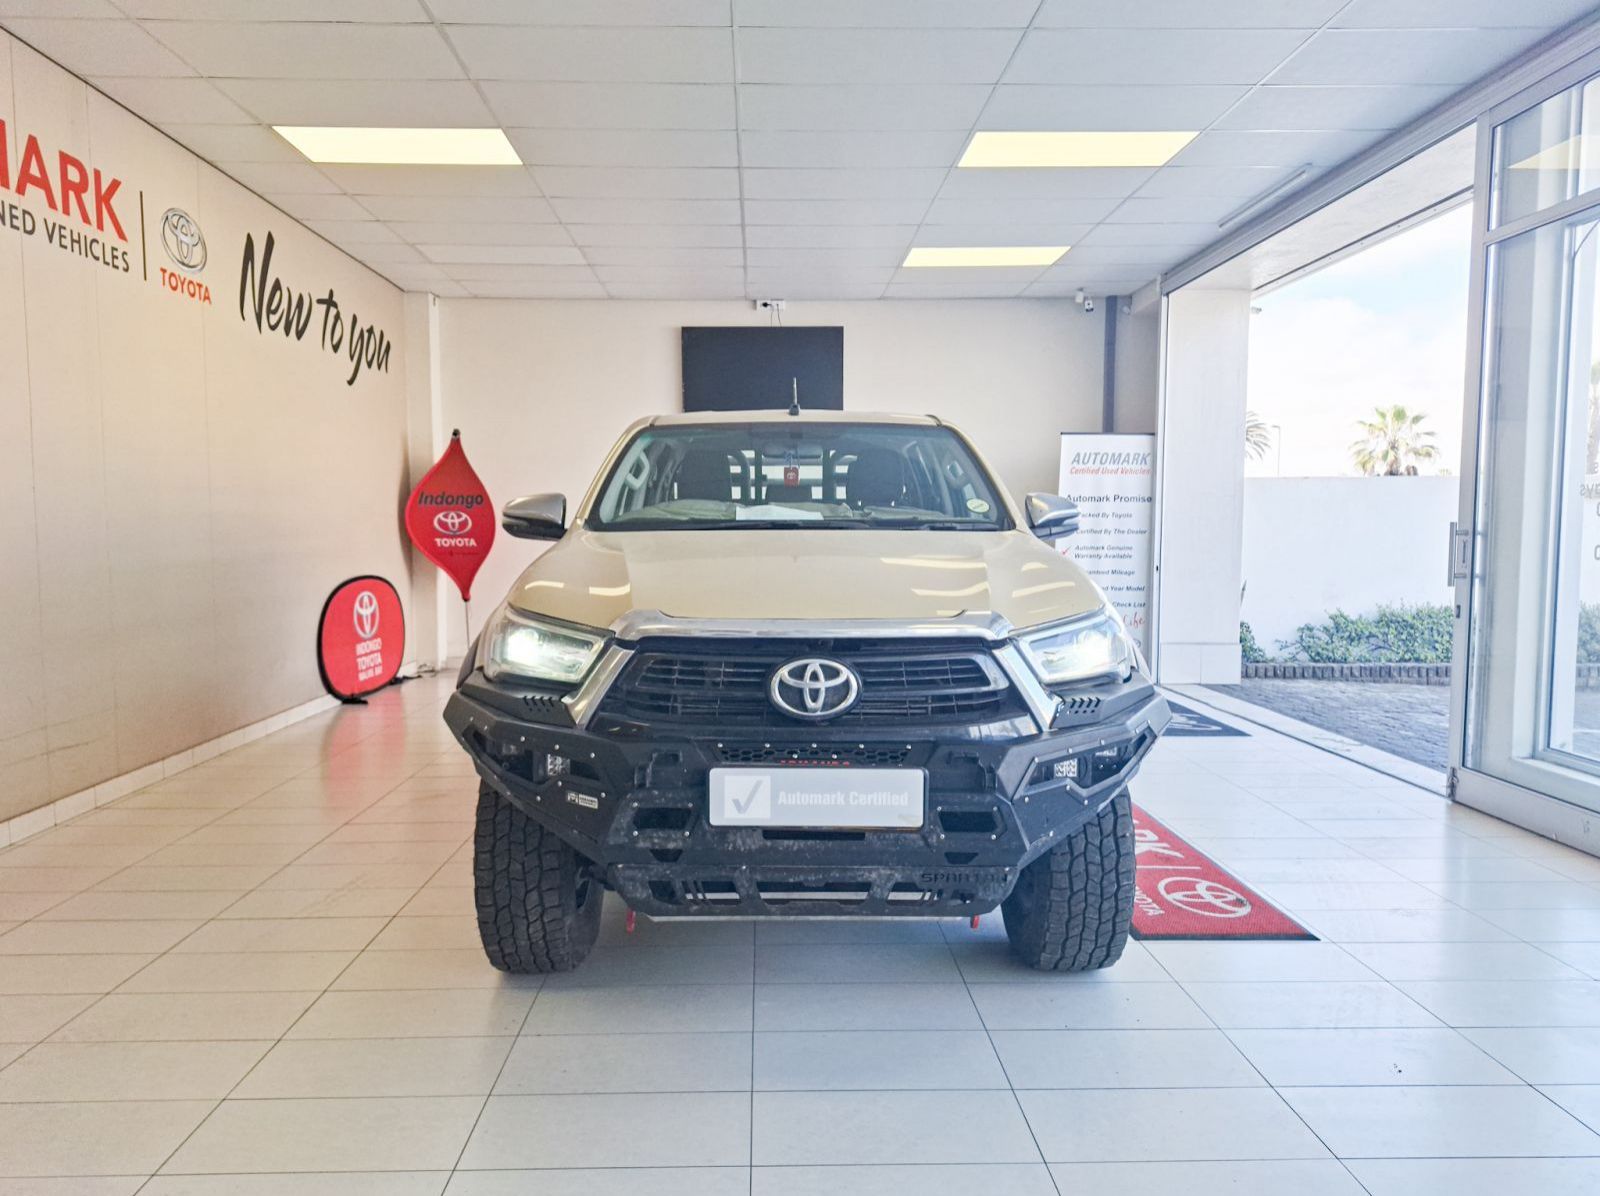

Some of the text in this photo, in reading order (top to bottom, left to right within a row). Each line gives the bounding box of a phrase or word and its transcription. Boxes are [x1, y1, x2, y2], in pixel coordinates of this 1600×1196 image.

[43, 216, 130, 273] VEHICLES
[160, 266, 212, 305] TOYOTA
[239, 230, 391, 387] New to you
[1071, 451, 1151, 466] AUTOMARK
[1070, 467, 1152, 476] Certified Used Vehicles
[418, 491, 484, 509] Indongo
[1065, 494, 1153, 503] Automark Promise
[434, 538, 478, 547] TOYOTA
[778, 791, 910, 805] Automark Certified
